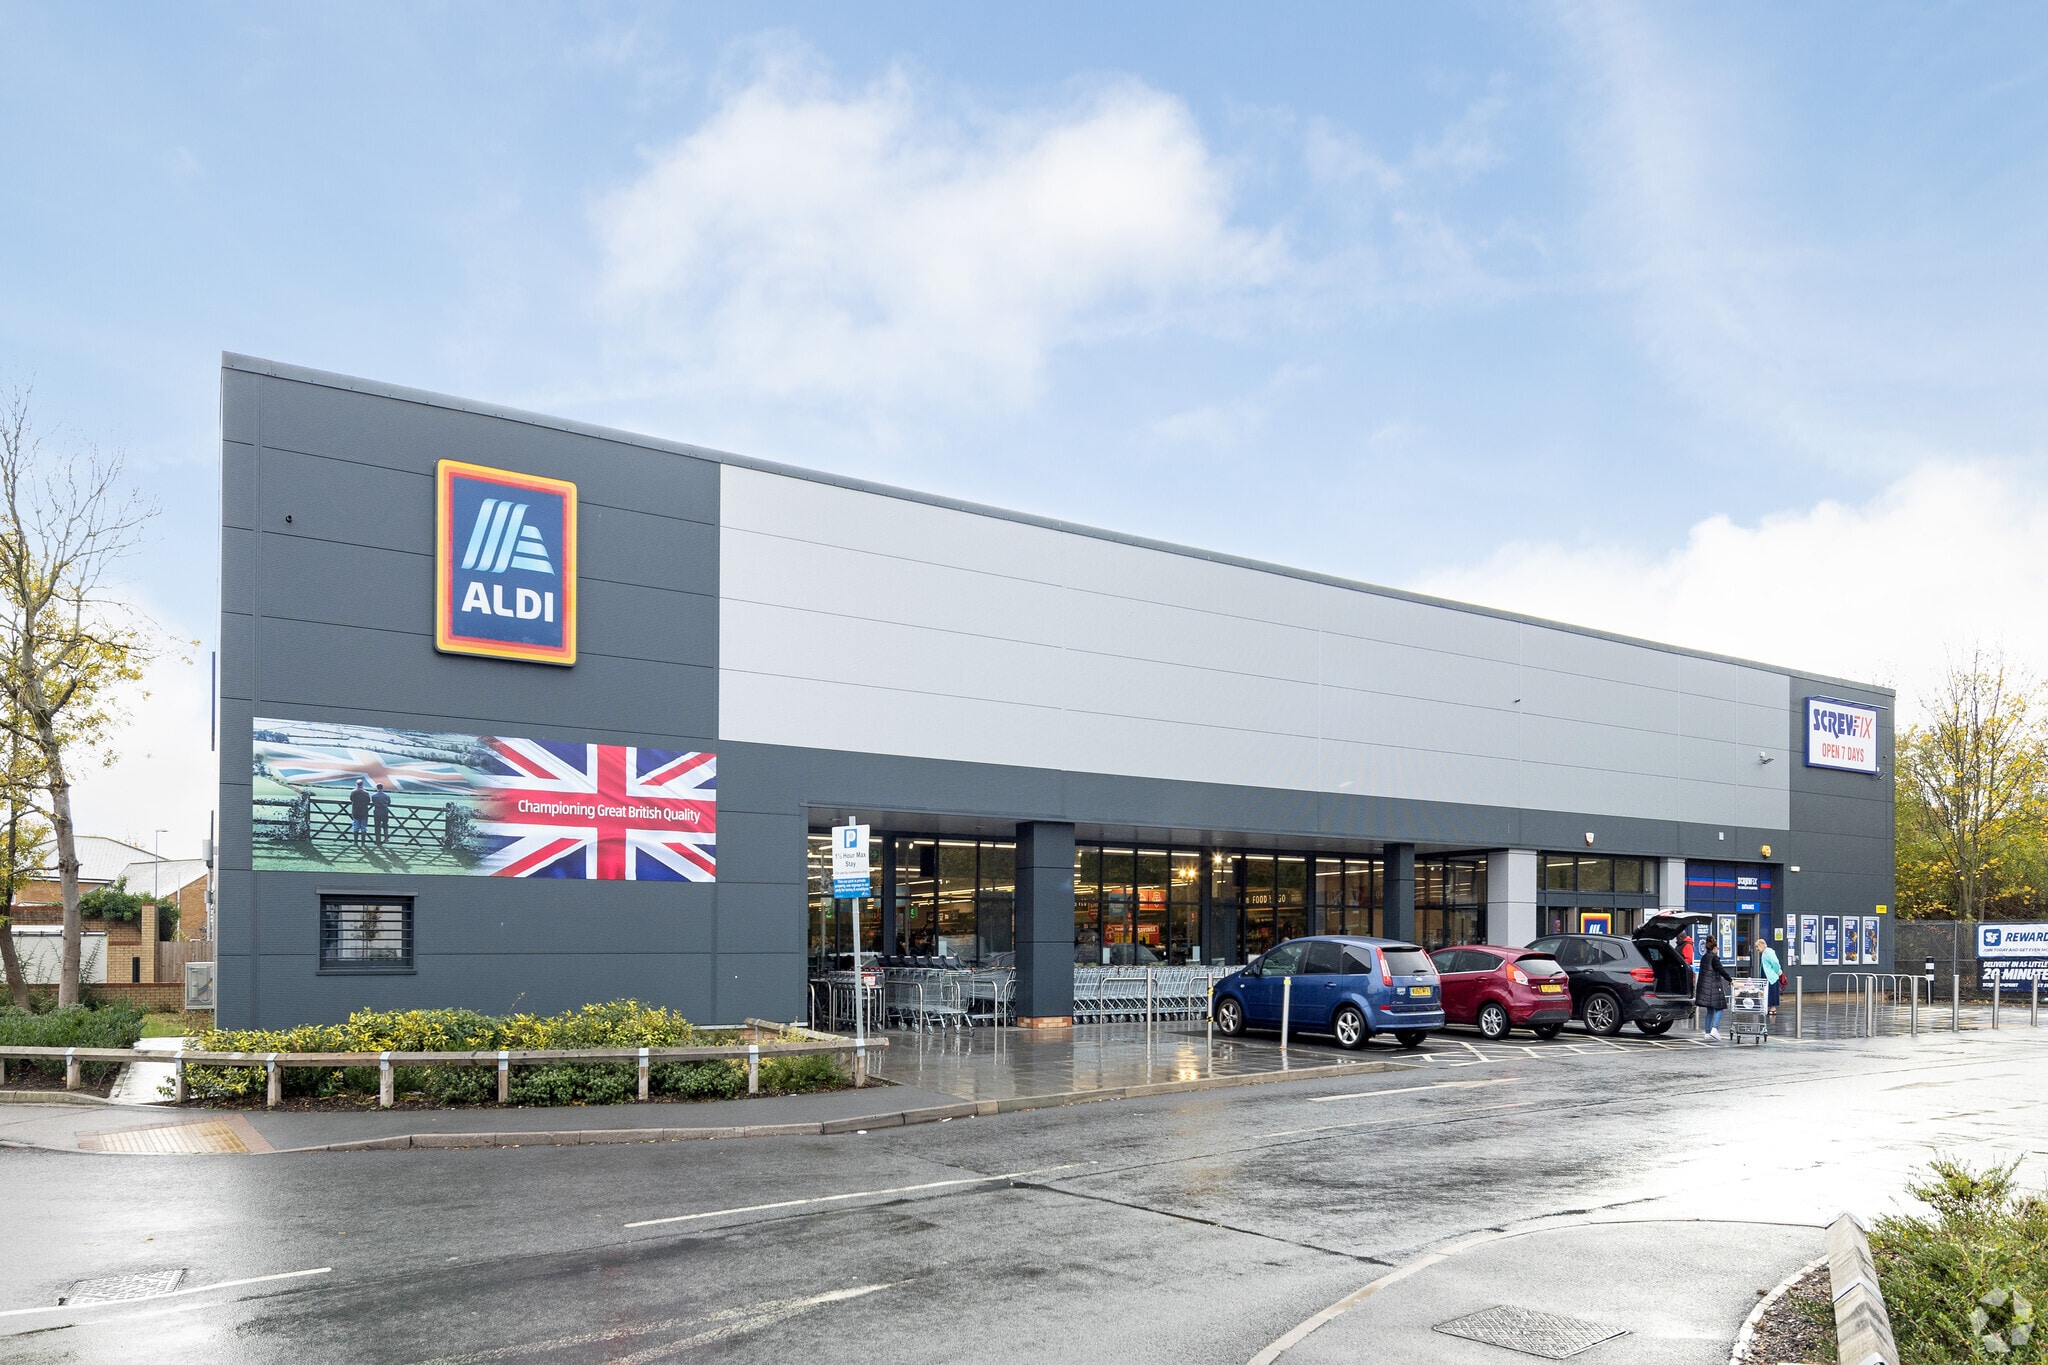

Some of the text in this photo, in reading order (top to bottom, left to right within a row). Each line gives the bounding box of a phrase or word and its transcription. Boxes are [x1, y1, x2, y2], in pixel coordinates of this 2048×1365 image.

[461, 581, 554, 623] ALDI
[1813, 708, 1873, 739] SCREWFIX
[1822, 742, 1865, 763] OPEN 7 DAYS
[517, 799, 701, 824] Championing Great British Quality
[845, 860, 856, 868] Stay
[1252, 895, 1268, 904] FOOD
